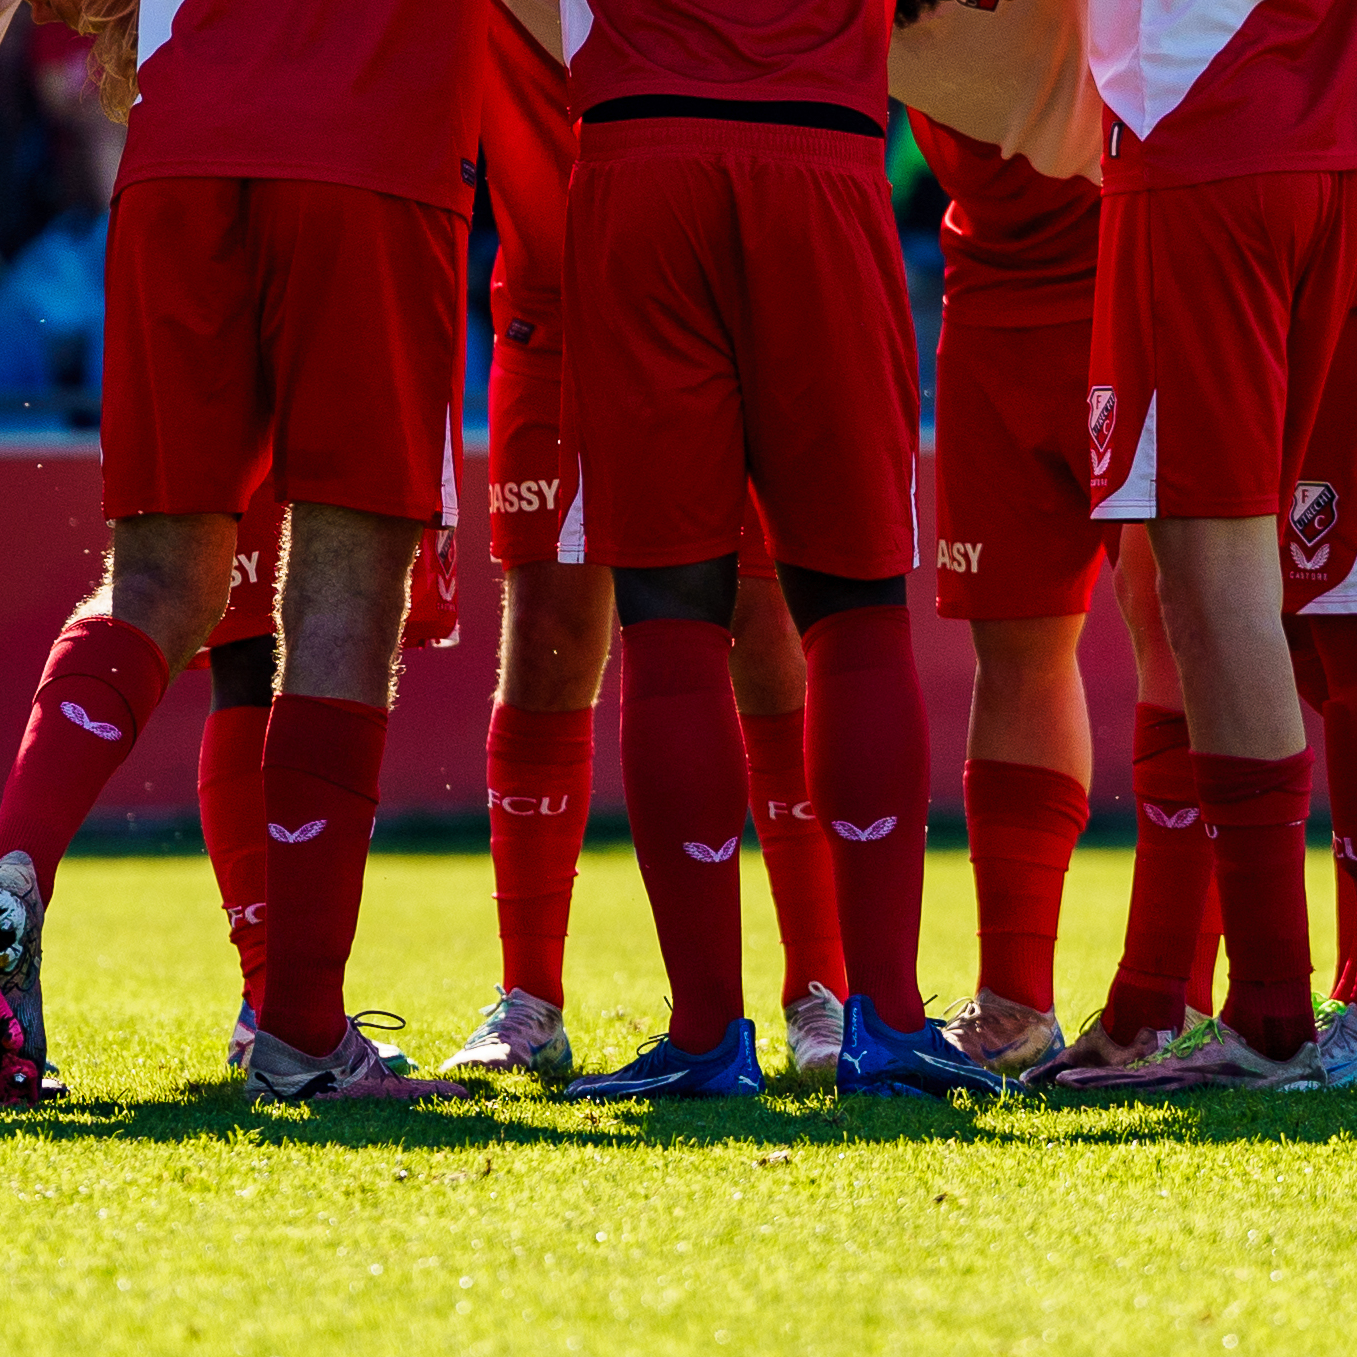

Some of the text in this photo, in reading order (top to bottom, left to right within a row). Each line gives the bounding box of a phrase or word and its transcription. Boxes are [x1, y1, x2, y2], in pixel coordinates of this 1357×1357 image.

[1295, 487, 1332, 530] UTRECHT
[487, 788, 569, 816] FCU
[768, 800, 816, 821] FC
